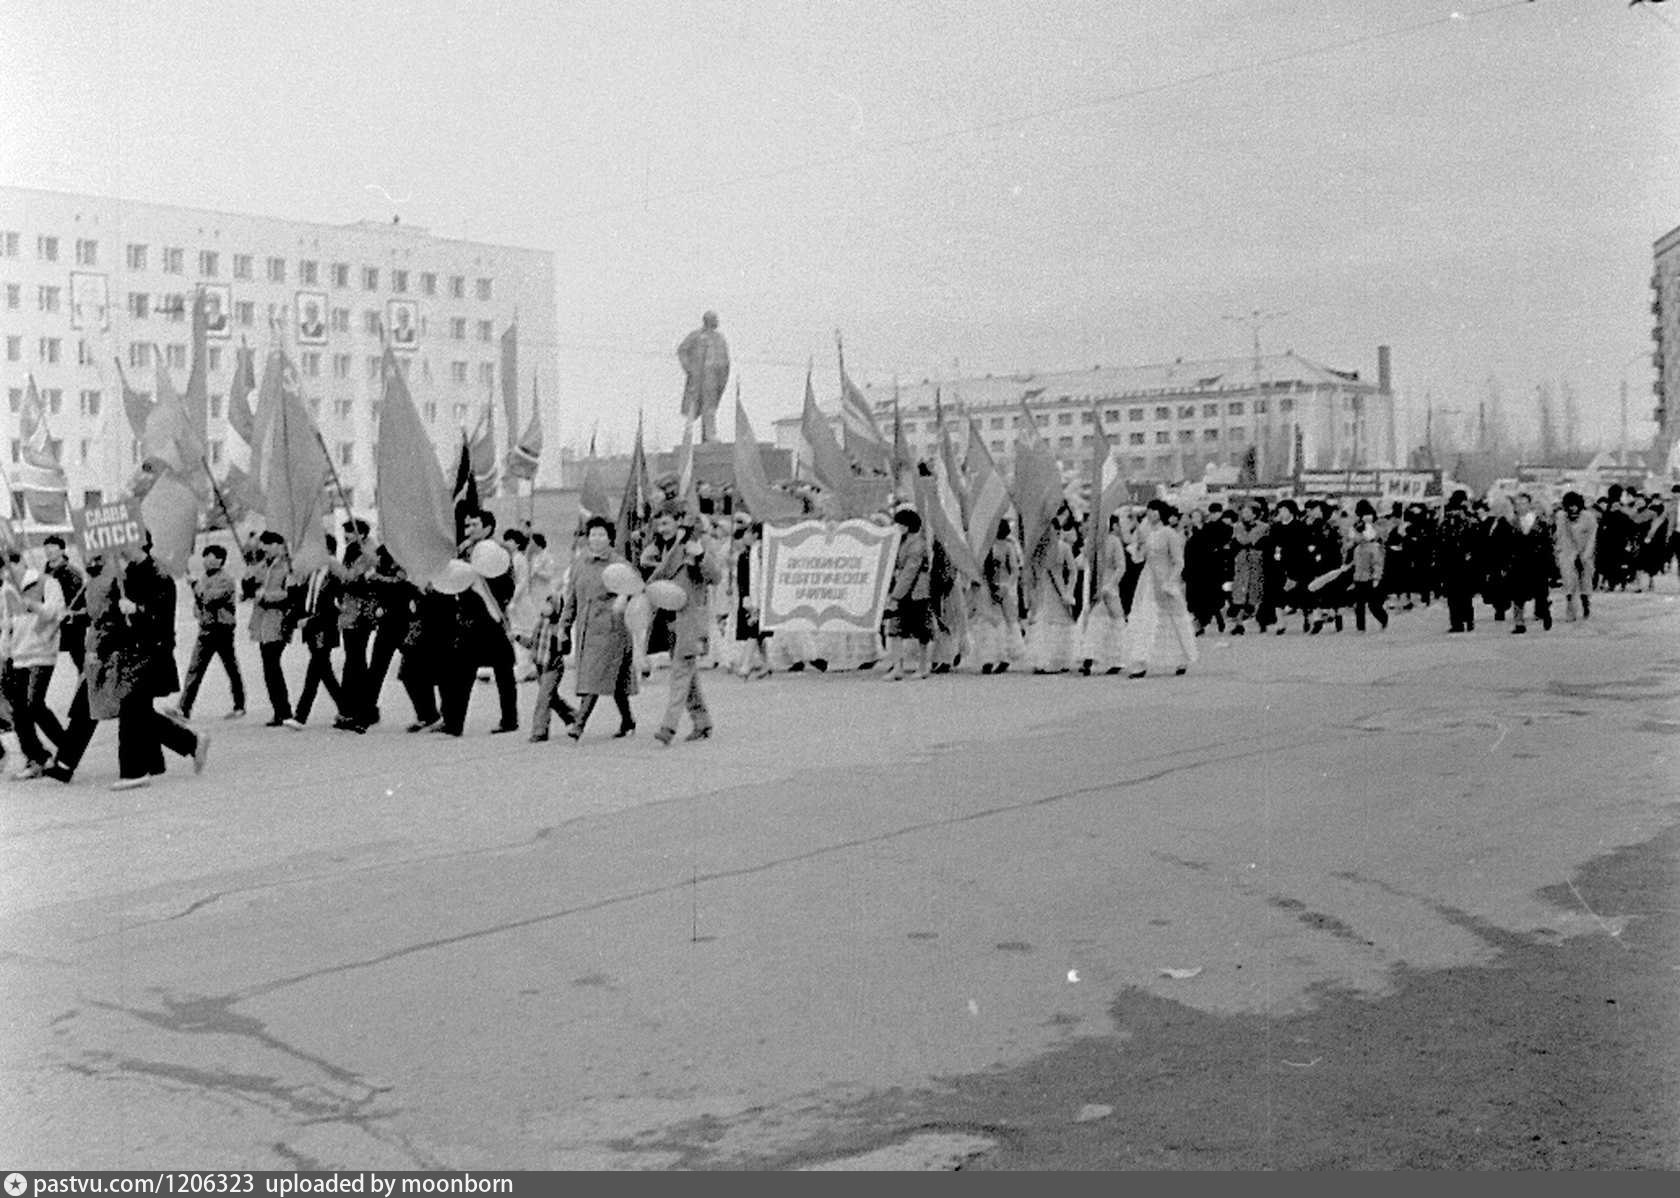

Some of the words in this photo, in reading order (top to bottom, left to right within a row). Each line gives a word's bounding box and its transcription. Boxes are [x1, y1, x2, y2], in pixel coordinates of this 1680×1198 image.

[1387, 479, 1422, 497] МИР
[84, 504, 129, 527] СЛАВА
[84, 521, 140, 550] КПСС
